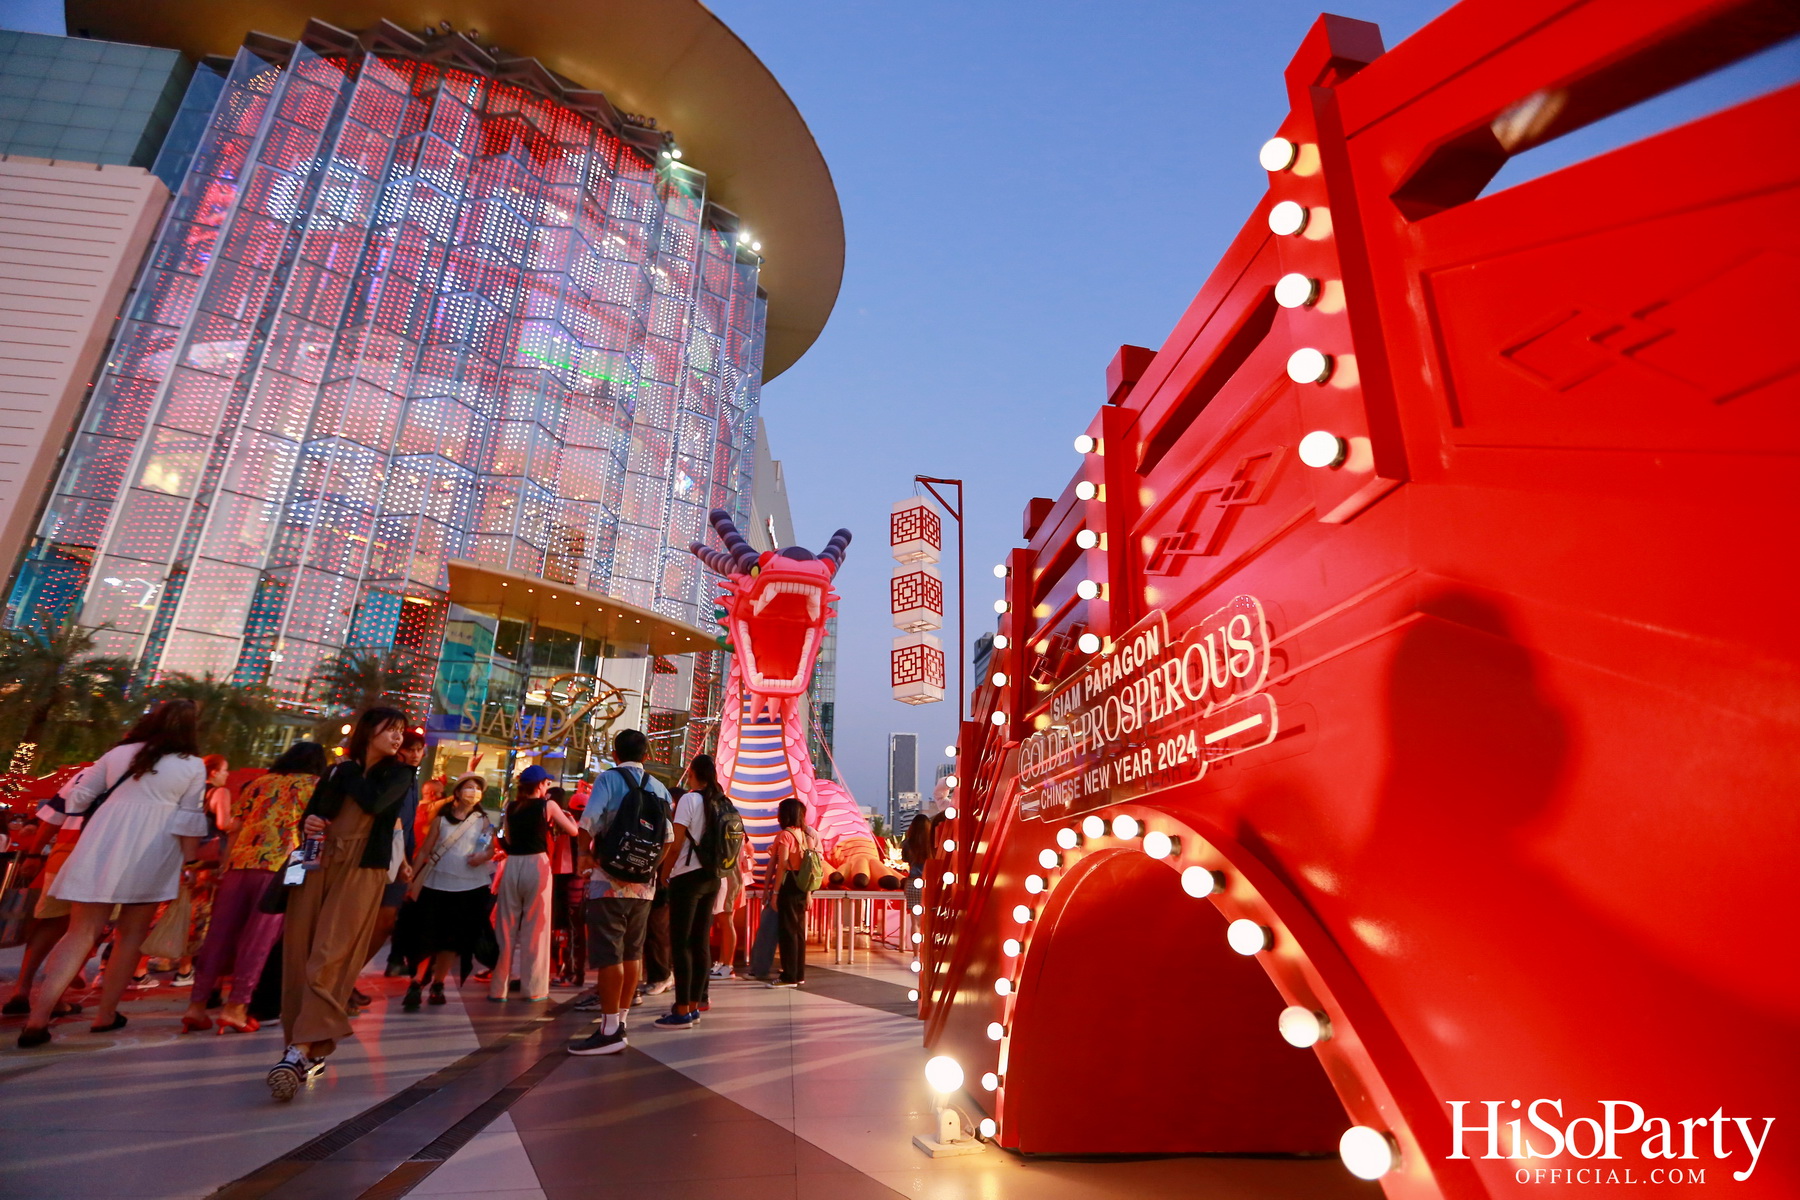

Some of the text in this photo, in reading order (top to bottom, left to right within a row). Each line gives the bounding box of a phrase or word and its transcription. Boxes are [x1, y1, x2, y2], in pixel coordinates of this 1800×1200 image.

[1020, 613, 1256, 782] GOLDEN PROSPEROUS
[1053, 624, 1160, 721] SIAM PARAGON
[459, 700, 538, 744] SIAM
[1041, 729, 1198, 810] CHINESE NEW YEAR 2024
